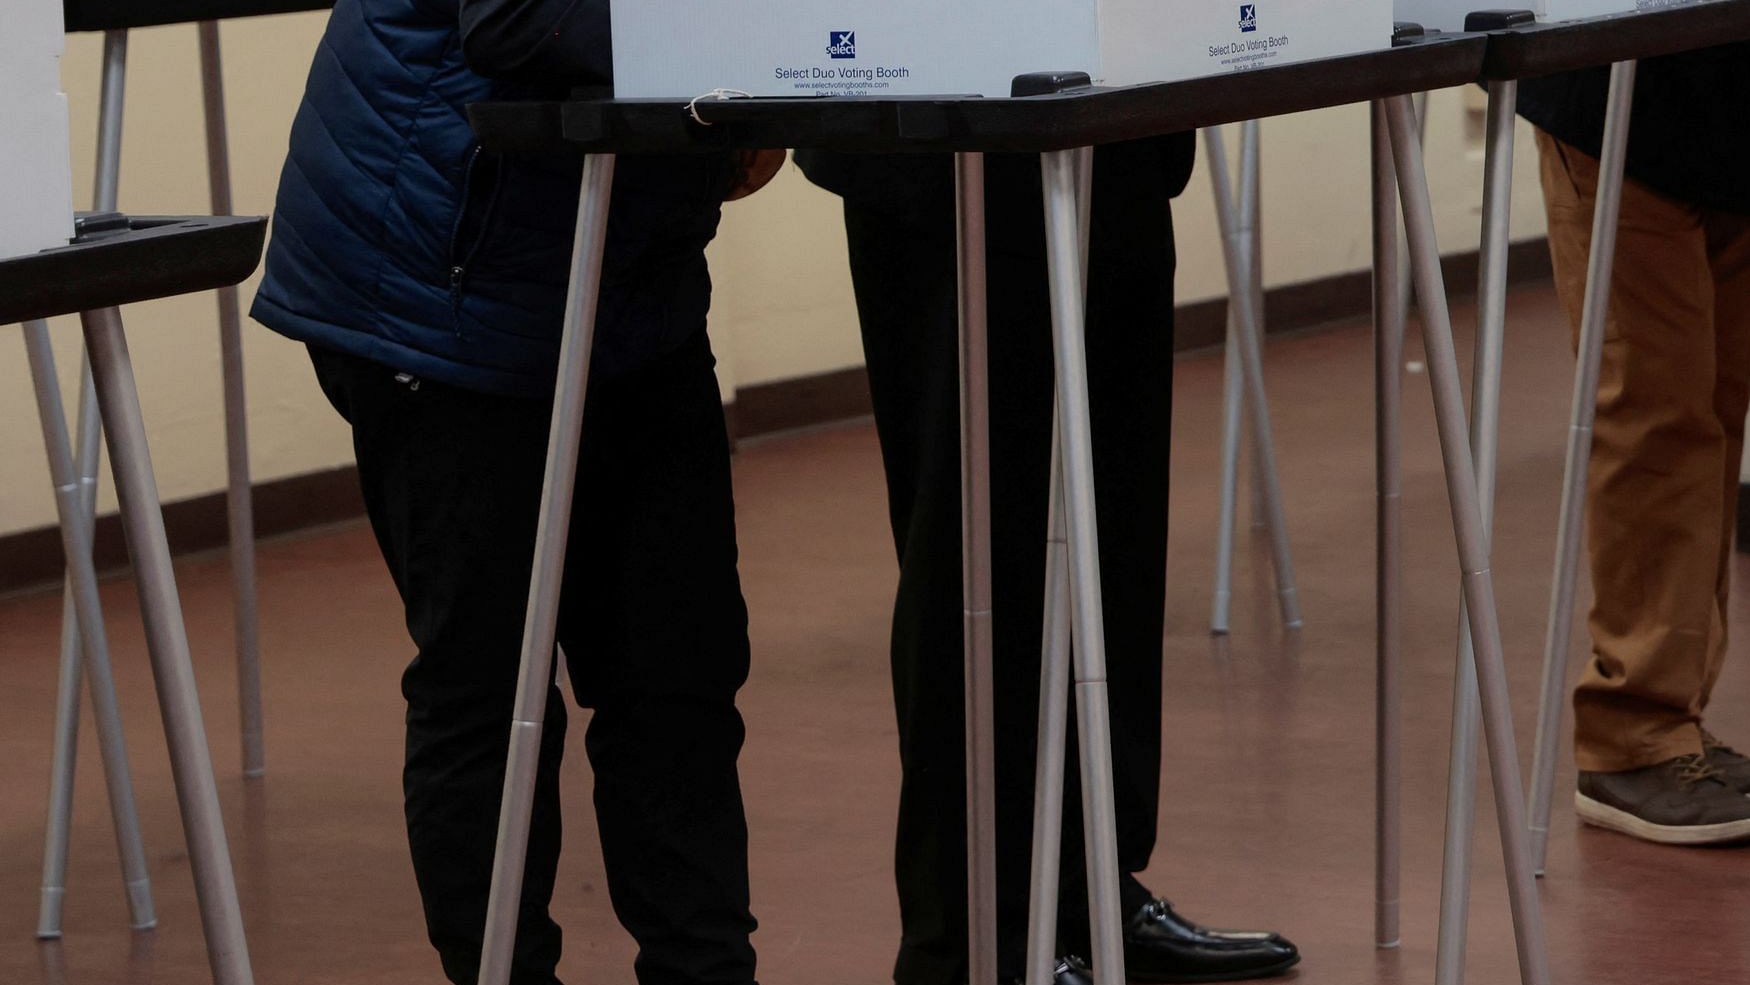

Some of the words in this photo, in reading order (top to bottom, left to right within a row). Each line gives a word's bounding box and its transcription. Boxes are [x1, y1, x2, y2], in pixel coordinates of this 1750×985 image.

[826, 43, 856, 55] select
[1208, 44, 1230, 57] Select
[1231, 42, 1245, 53] Duo
[1246, 38, 1267, 51] Voting
[1268, 34, 1289, 47] Booth
[775, 67, 809, 79] Select
[812, 67, 835, 79] Duo
[838, 67, 873, 80] Voting
[876, 66, 909, 78] Booth
